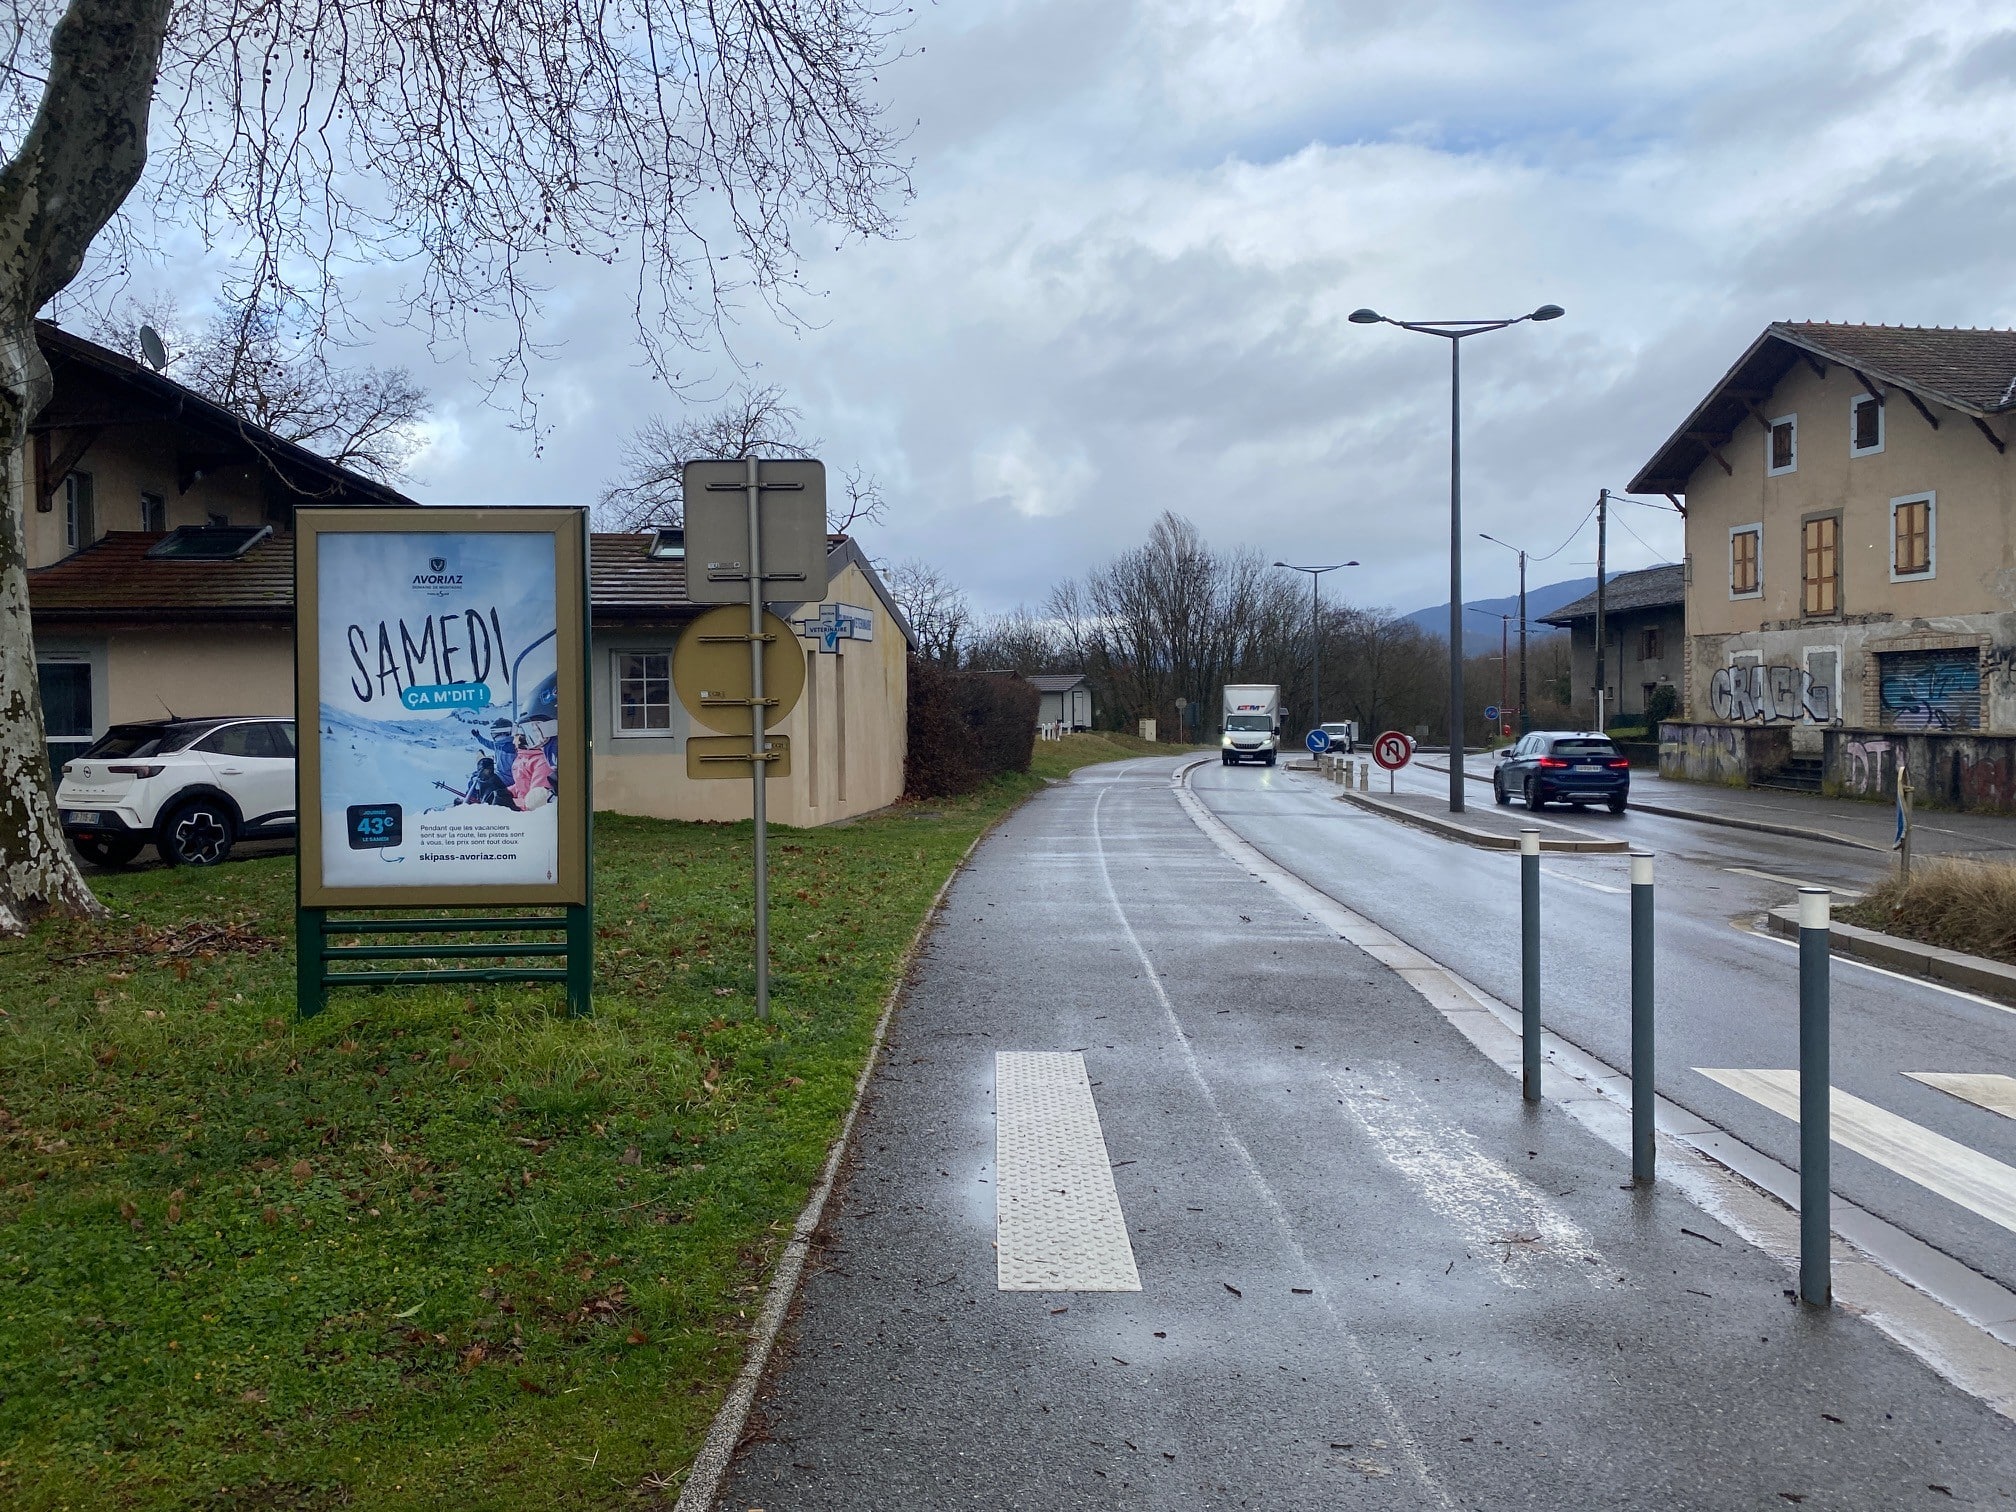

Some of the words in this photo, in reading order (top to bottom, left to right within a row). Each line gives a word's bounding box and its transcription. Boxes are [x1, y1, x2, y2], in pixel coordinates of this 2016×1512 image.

[412, 575, 463, 584] AVORIAZ
[347, 606, 510, 703] SAMEDI
[408, 692, 430, 707] ÇA
[434, 689, 475, 703] M'DIT
[358, 816, 394, 834] 43€
[419, 852, 517, 862] skipass-avoriaz.com
